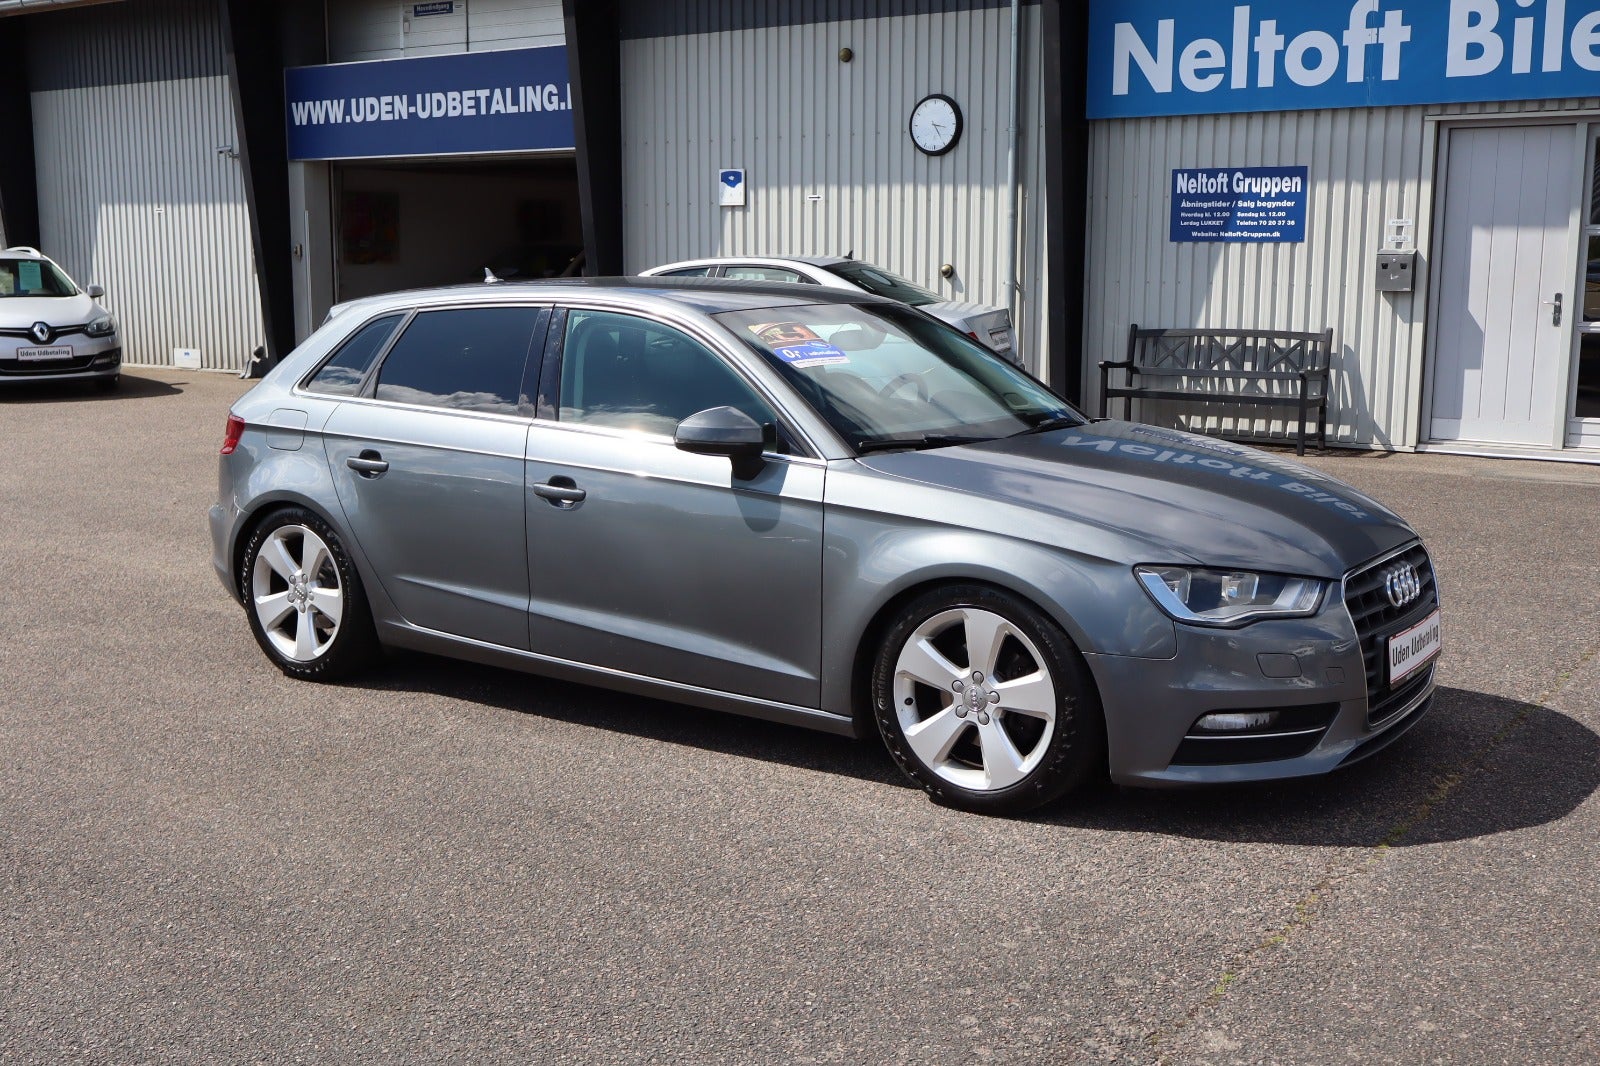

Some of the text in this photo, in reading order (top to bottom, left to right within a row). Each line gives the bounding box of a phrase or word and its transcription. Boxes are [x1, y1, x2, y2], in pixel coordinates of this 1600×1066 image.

[1112, 0, 1412, 96] Neltoft
[1176, 171, 1302, 198] Neltoft Gruppen
[1180, 199, 1230, 208] Åbningstider
[1237, 200, 1255, 209] Salg
[1256, 200, 1296, 209] begynder
[37, 349, 70, 357] Udbetaling
[1391, 624, 1439, 668] Uden Udbetaling
